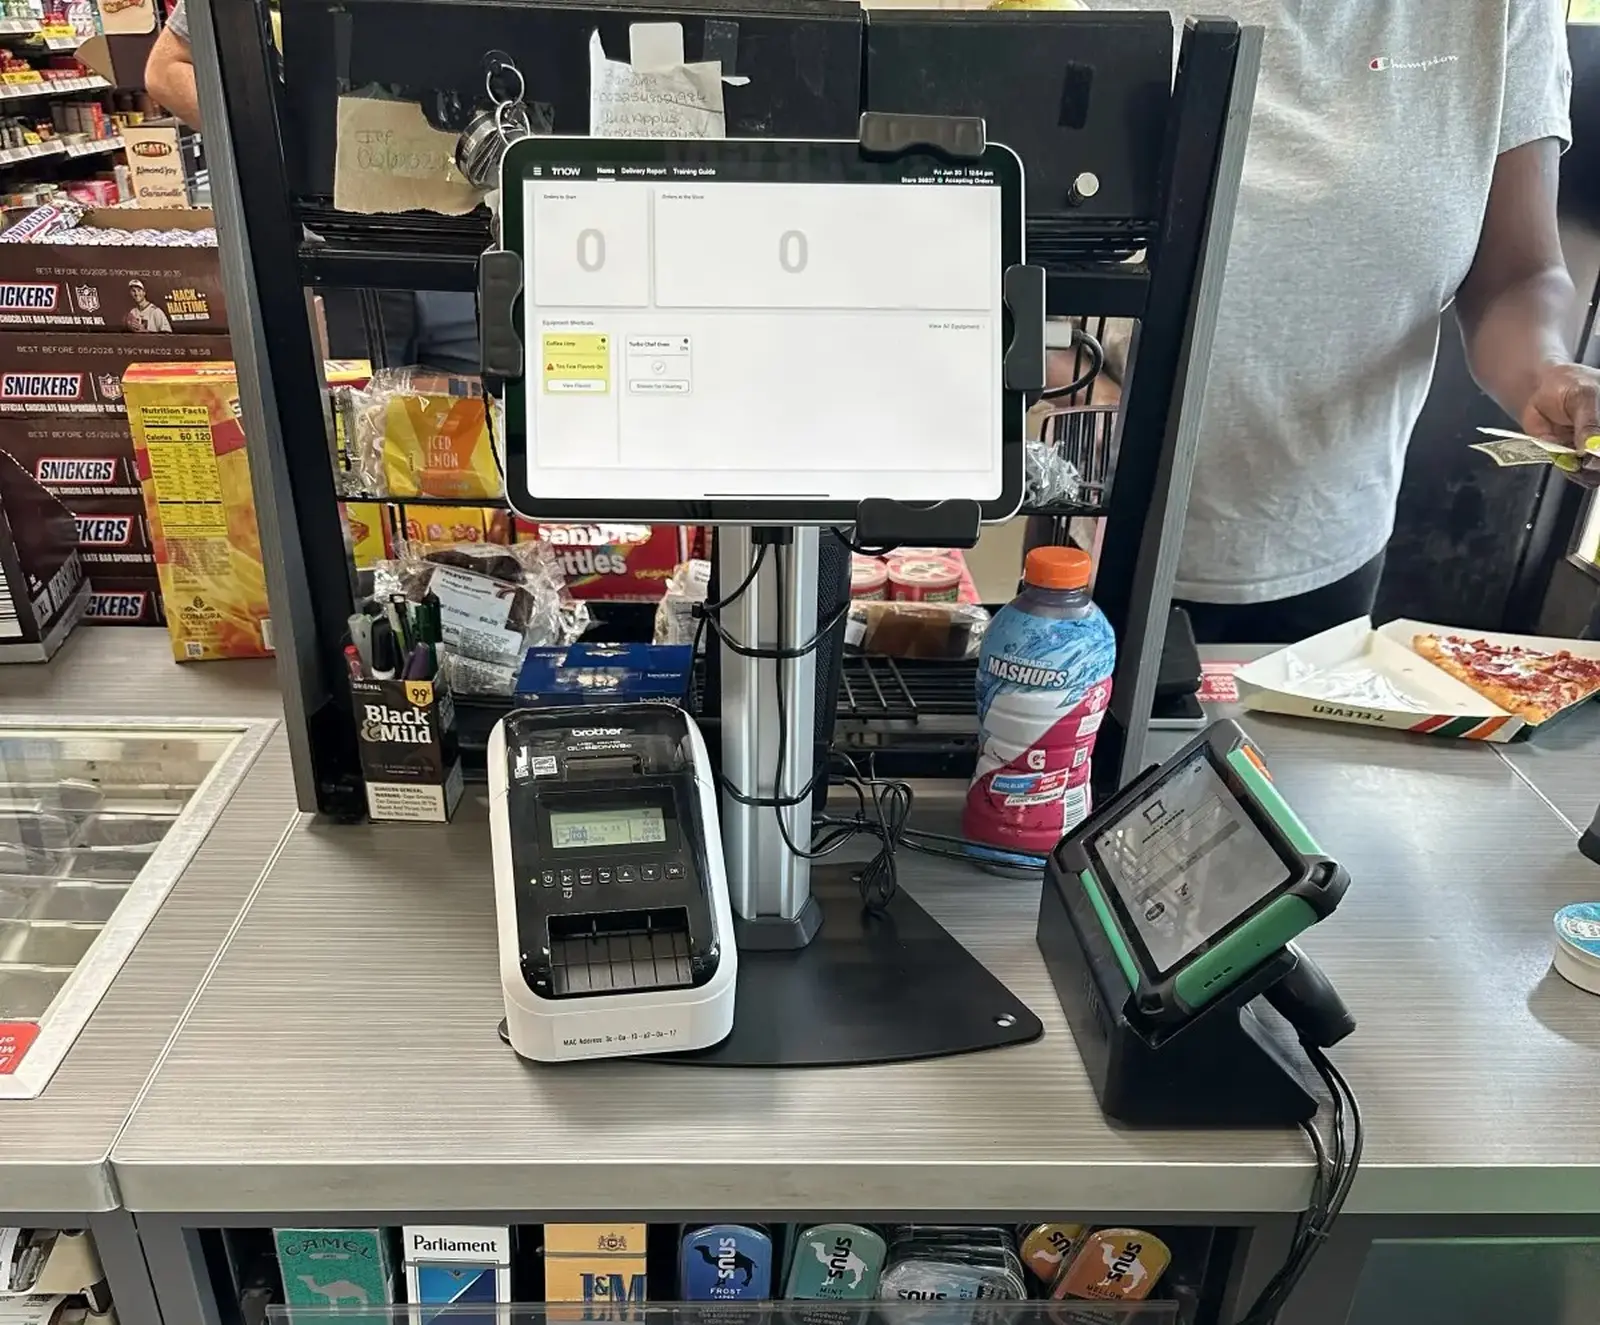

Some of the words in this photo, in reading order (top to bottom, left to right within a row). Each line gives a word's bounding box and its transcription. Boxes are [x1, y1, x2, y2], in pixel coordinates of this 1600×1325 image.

[1368, 54, 1460, 71] Champion
[597, 167, 615, 175] Home
[621, 167, 645, 176] Delivery
[647, 167, 667, 177] Report
[673, 168, 697, 177] Training
[698, 168, 716, 176] Guide
[576, 228, 606, 273] 0
[779, 229, 808, 274] 0
[0, 285, 55, 308] ICKERS
[17, 345, 39, 354] BEST
[42, 345, 73, 355] BEFORE
[4, 376, 78, 396] SNICKERS
[25, 403, 57, 412] CHOCOLATE
[142, 407, 180, 415] Nutrition
[182, 407, 207, 415] Facts
[52, 431, 82, 439] BEFORE
[180, 432, 192, 441] 60
[195, 432, 211, 441] 120
[428, 435, 451, 449] ICED
[40, 461, 113, 480] SNICKERS
[75, 520, 127, 541] KERS
[554, 547, 628, 576] ittles
[85, 595, 141, 617] CKERS
[1003, 653, 1050, 668] GATORADE
[987, 656, 1069, 688] MASHUPS
[364, 704, 430, 725] Black
[571, 728, 623, 737] brother
[285, 1235, 373, 1260] CAMEL
[413, 1234, 499, 1253] Parliament
[579, 1273, 648, 1323] L&M
[709, 1287, 742, 1295] FROST
[819, 1286, 844, 1296] MINT
[1086, 1284, 1124, 1300] MELLOW
